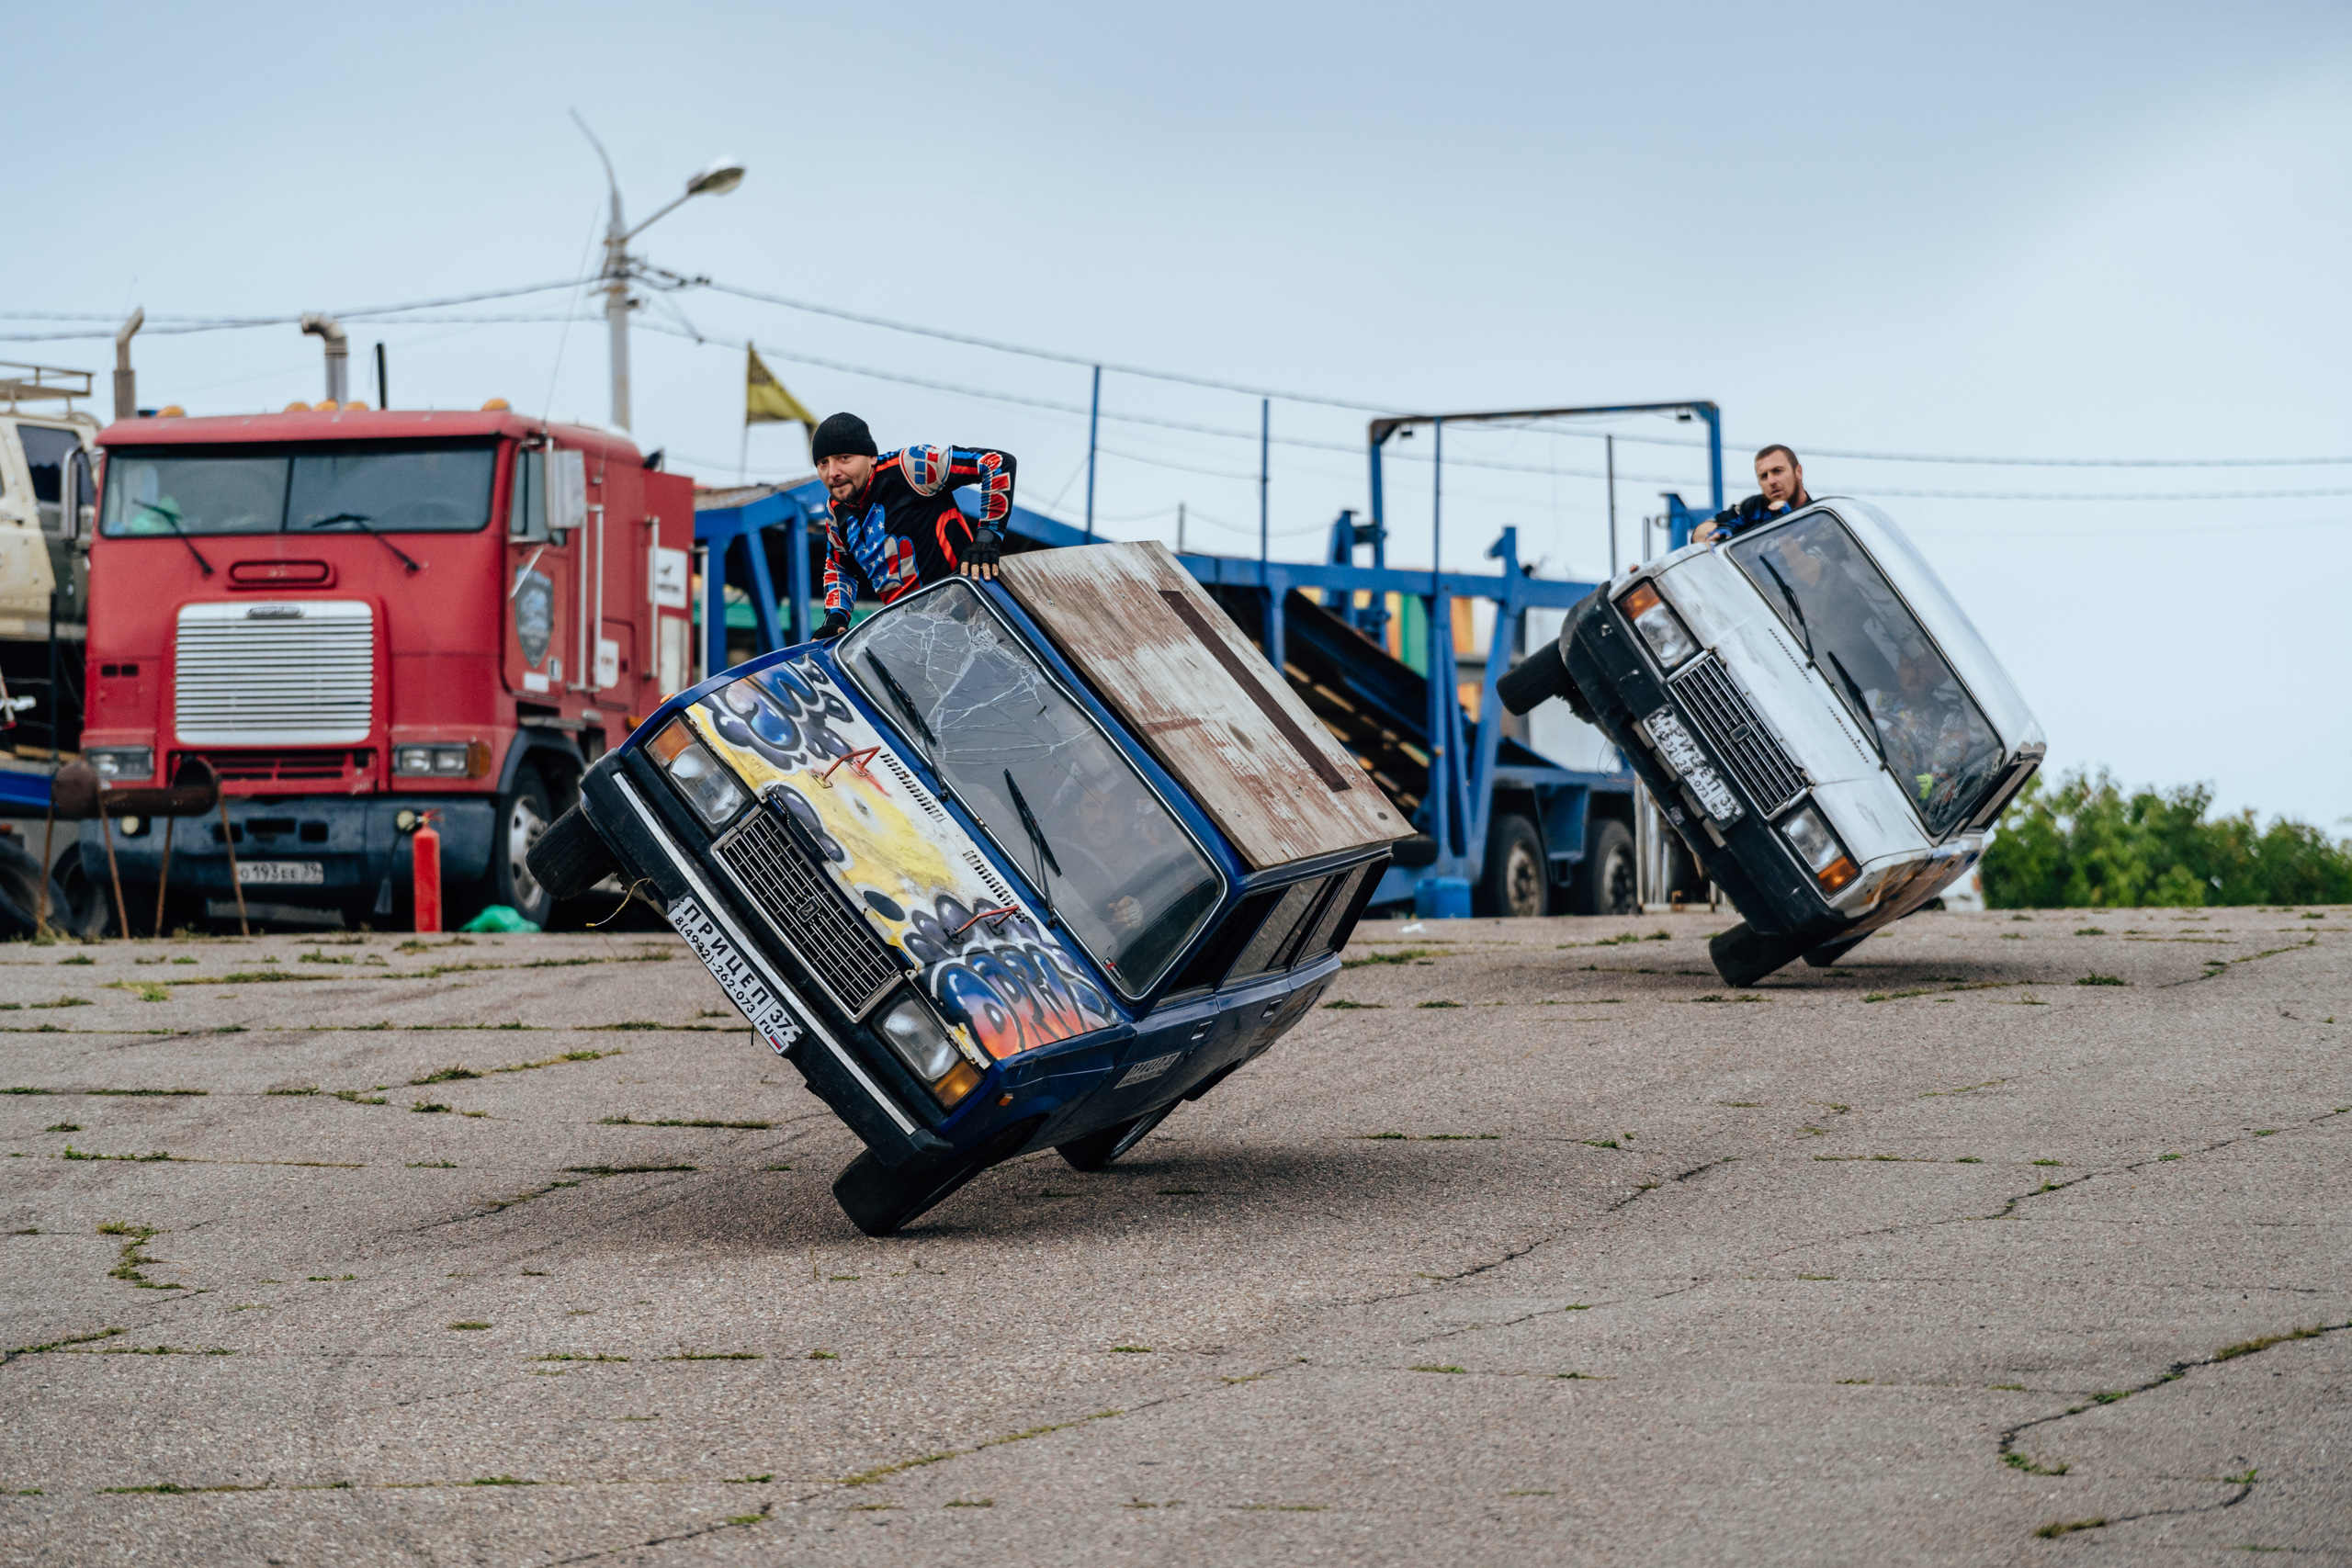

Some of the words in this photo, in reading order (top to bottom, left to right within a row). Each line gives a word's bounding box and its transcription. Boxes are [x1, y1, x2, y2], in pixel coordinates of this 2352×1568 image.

[675, 916, 755, 1014] 8(4932)-262-073
[759, 1019, 774, 1034] ru
[684, 904, 770, 1006] ПРИЦЕП
